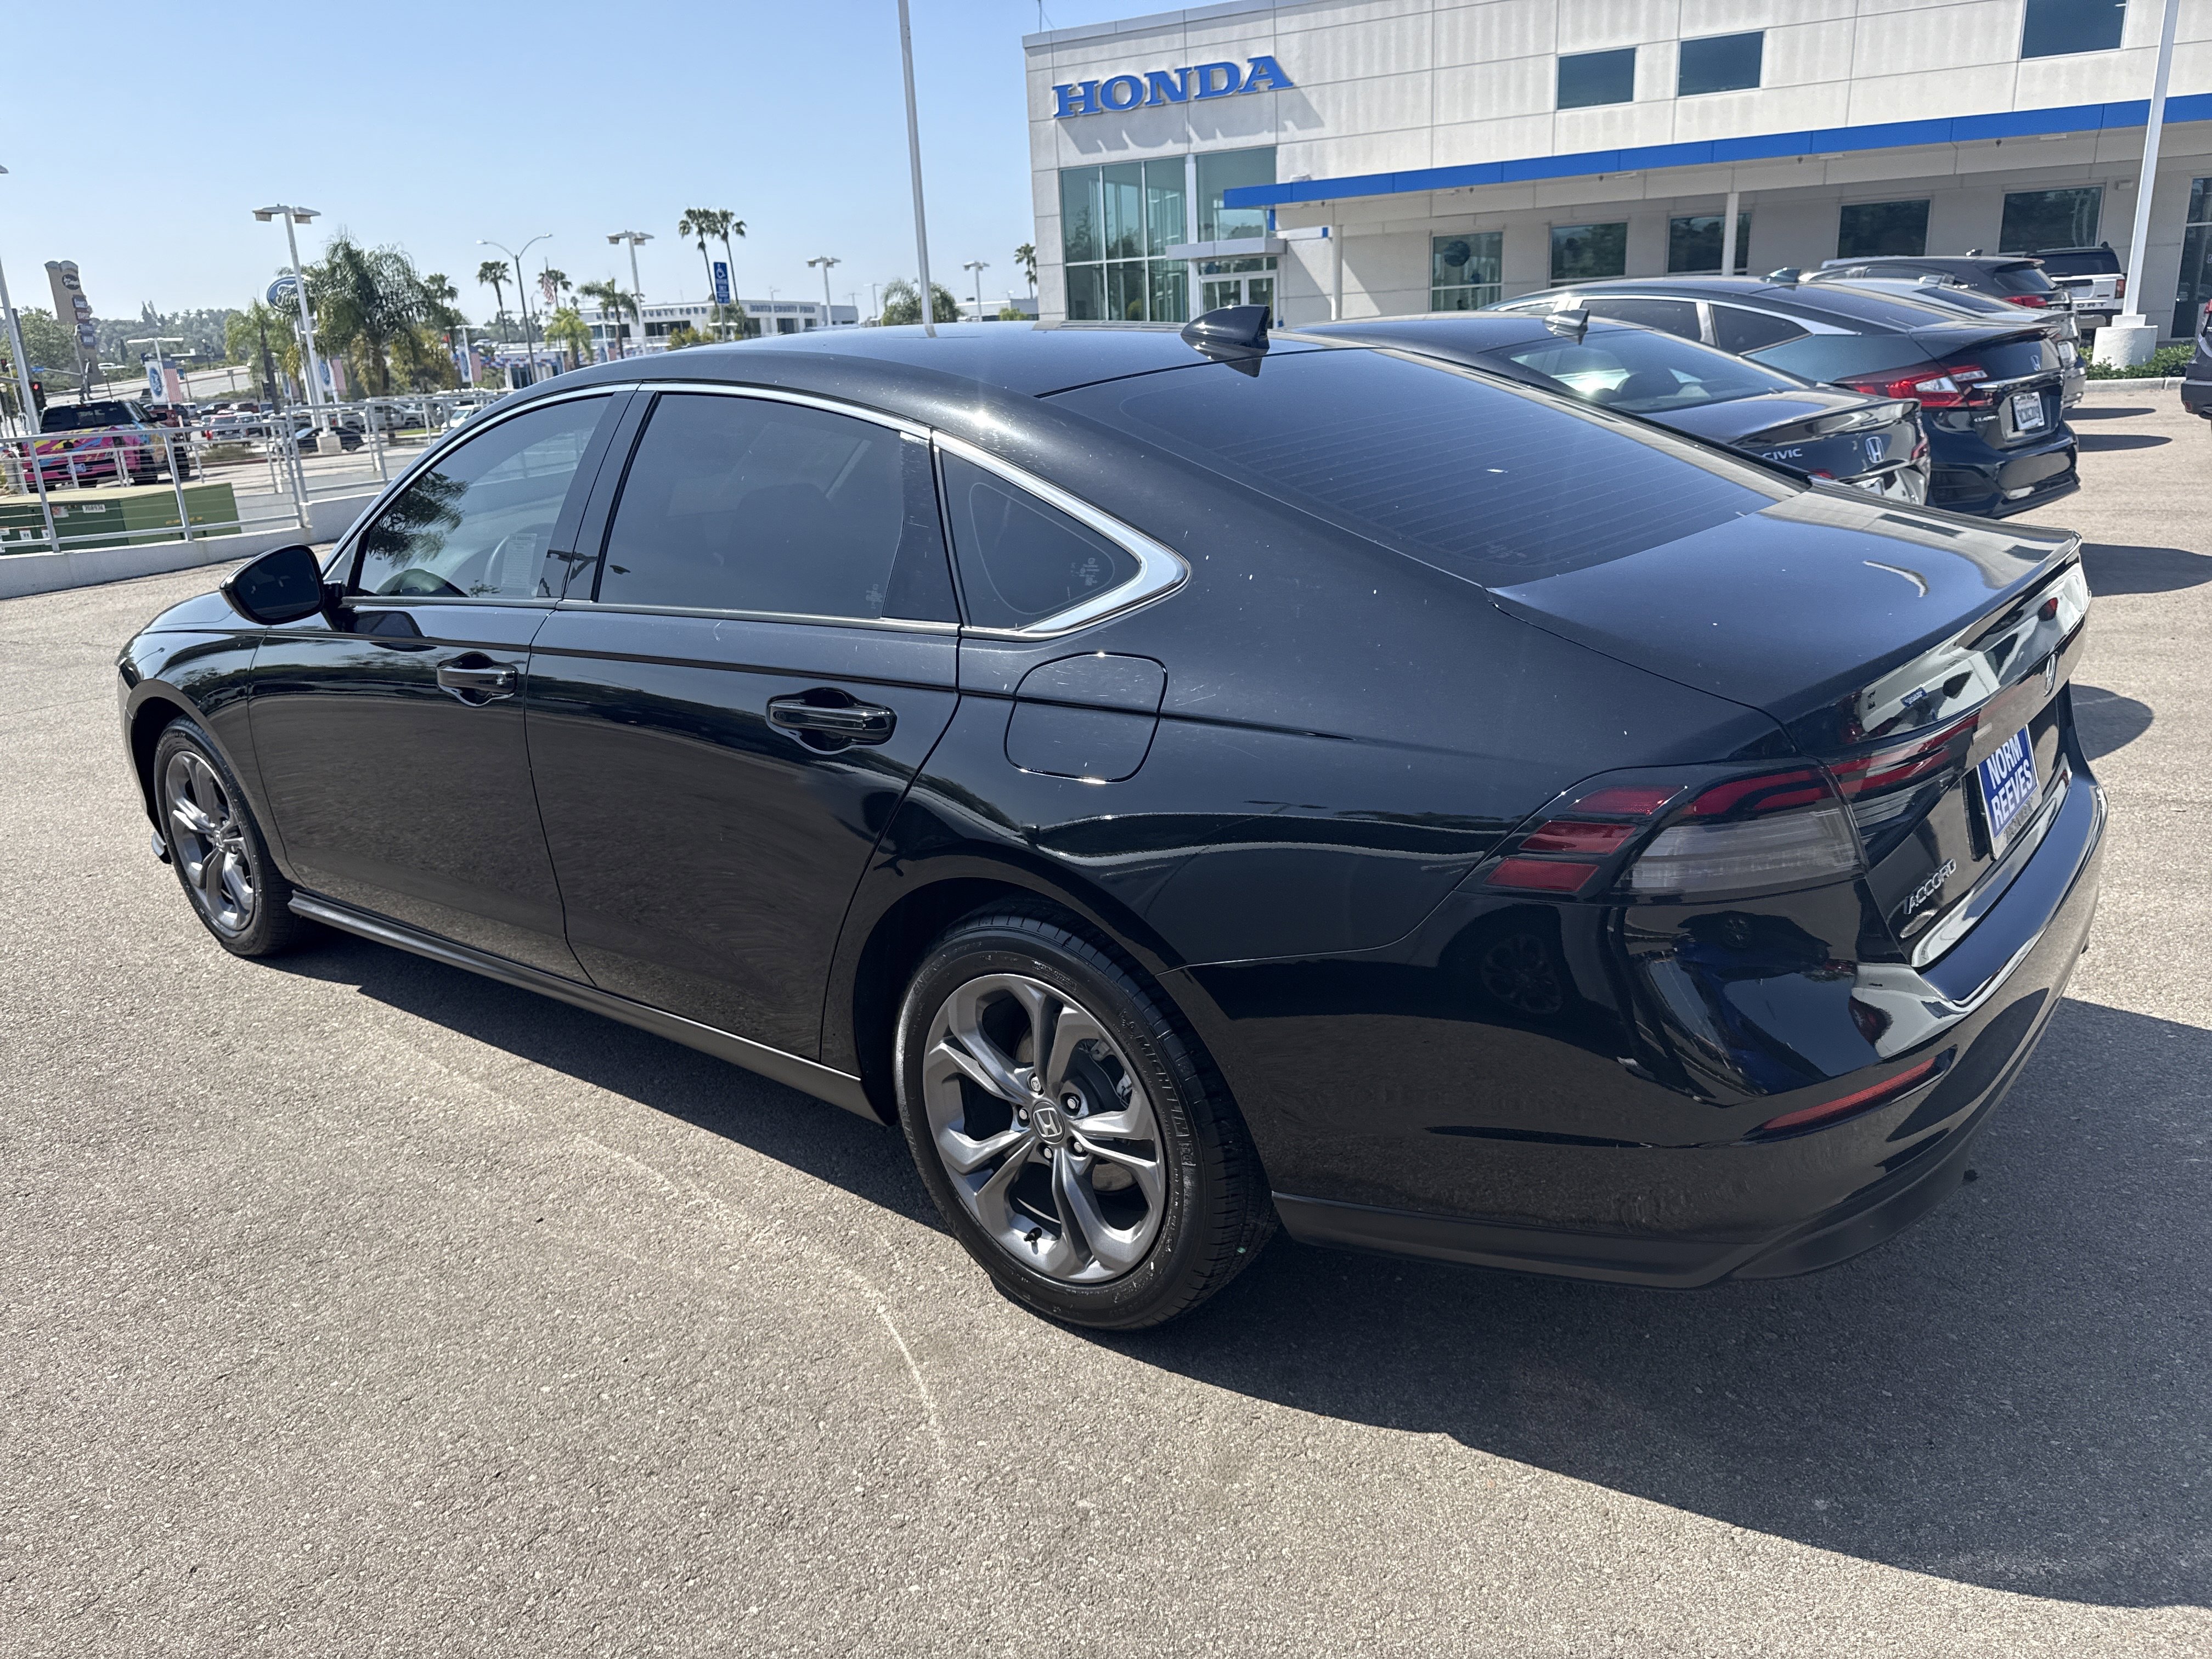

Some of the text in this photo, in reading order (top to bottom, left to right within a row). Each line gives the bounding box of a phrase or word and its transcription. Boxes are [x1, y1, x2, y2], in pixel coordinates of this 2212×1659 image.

[1052, 55, 1294, 119] HONDA
[1762, 448, 1803, 460] CIVIC
[1986, 733, 2023, 790] NORM
[1991, 759, 2033, 830] REEVES
[1904, 859, 1956, 915] ACCORD
